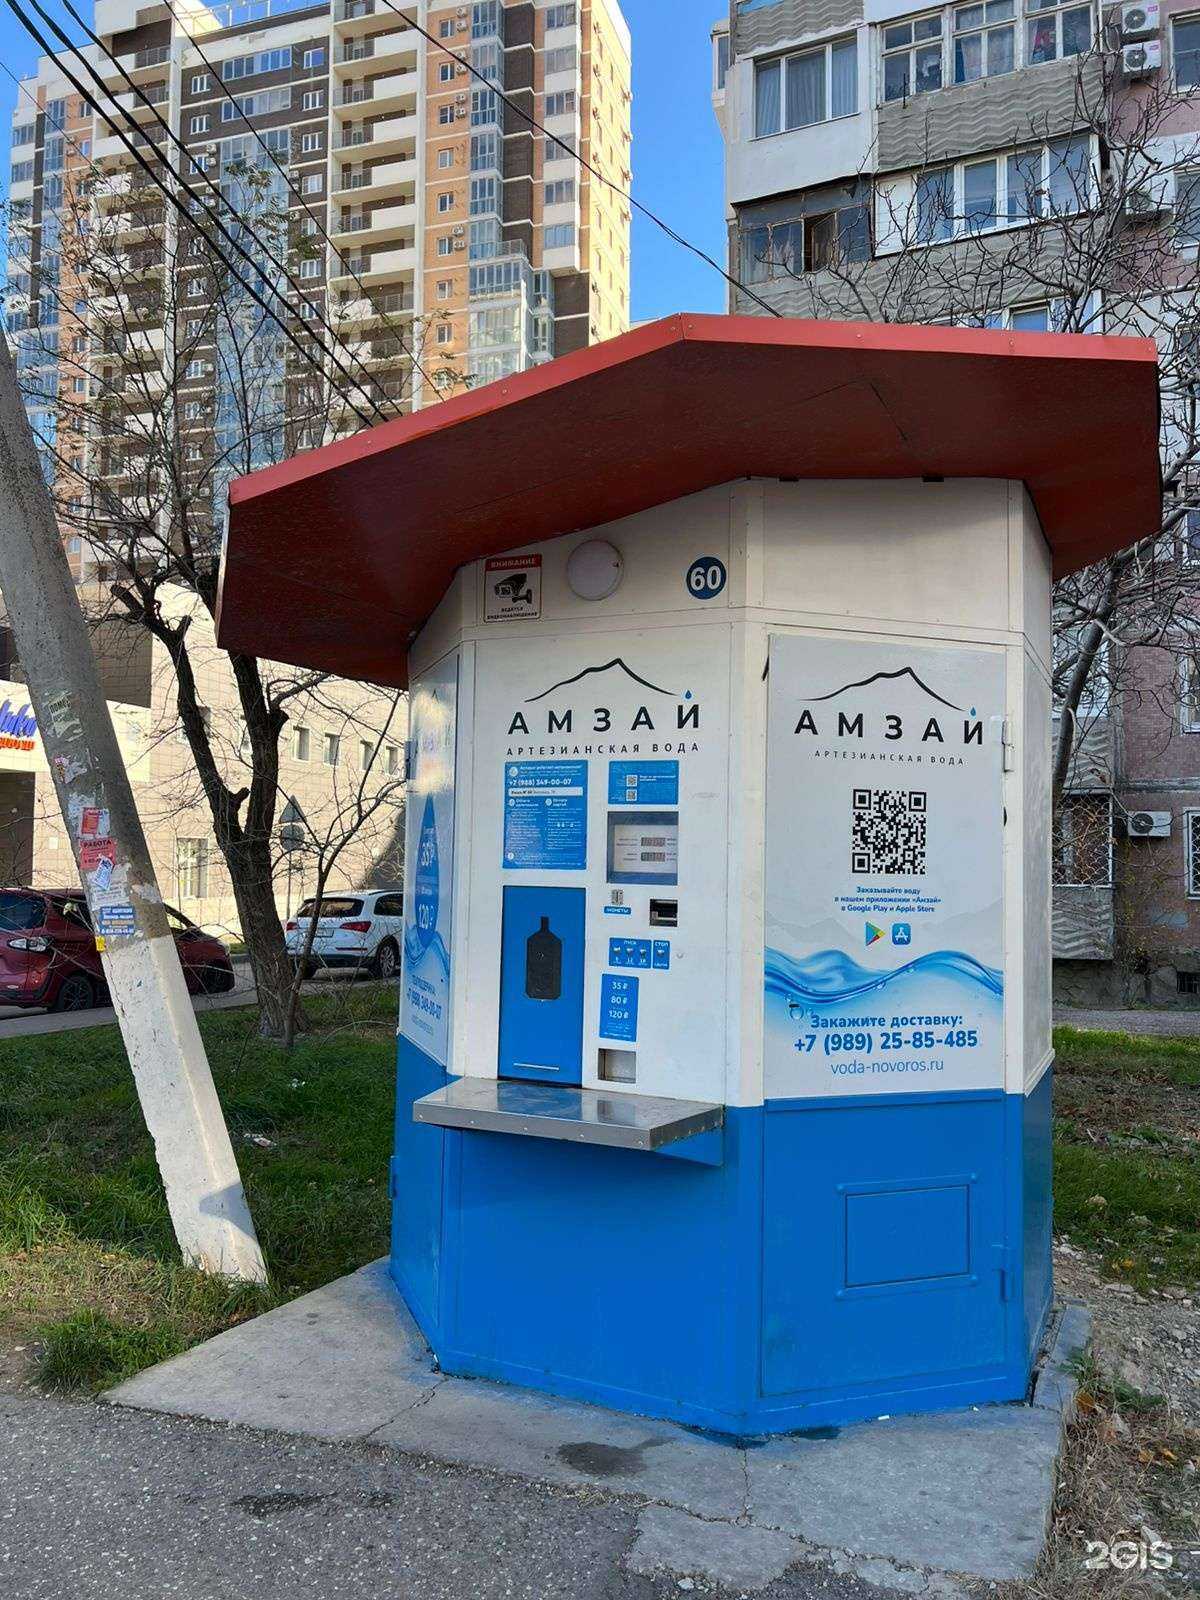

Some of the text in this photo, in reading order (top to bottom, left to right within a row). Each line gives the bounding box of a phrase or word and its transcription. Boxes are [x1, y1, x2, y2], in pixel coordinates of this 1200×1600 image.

[690, 565, 722, 591] 60
[507, 742, 699, 757] АРТЕЗИАНСКАЯ ВОДА
[814, 750, 964, 766] АРТЕЗИАНСКАЯ ВОДА
[847, 904, 871, 913] Google
[873, 904, 888, 913] Play
[895, 905, 915, 913] Apple
[612, 982, 622, 990] 35
[609, 1010, 623, 1019] 120
[811, 1014, 963, 1029] Закажите доставку:
[794, 1030, 978, 1056] +7 (989) 25-85-485
[830, 1058, 944, 1075] voda-novoros.ru
